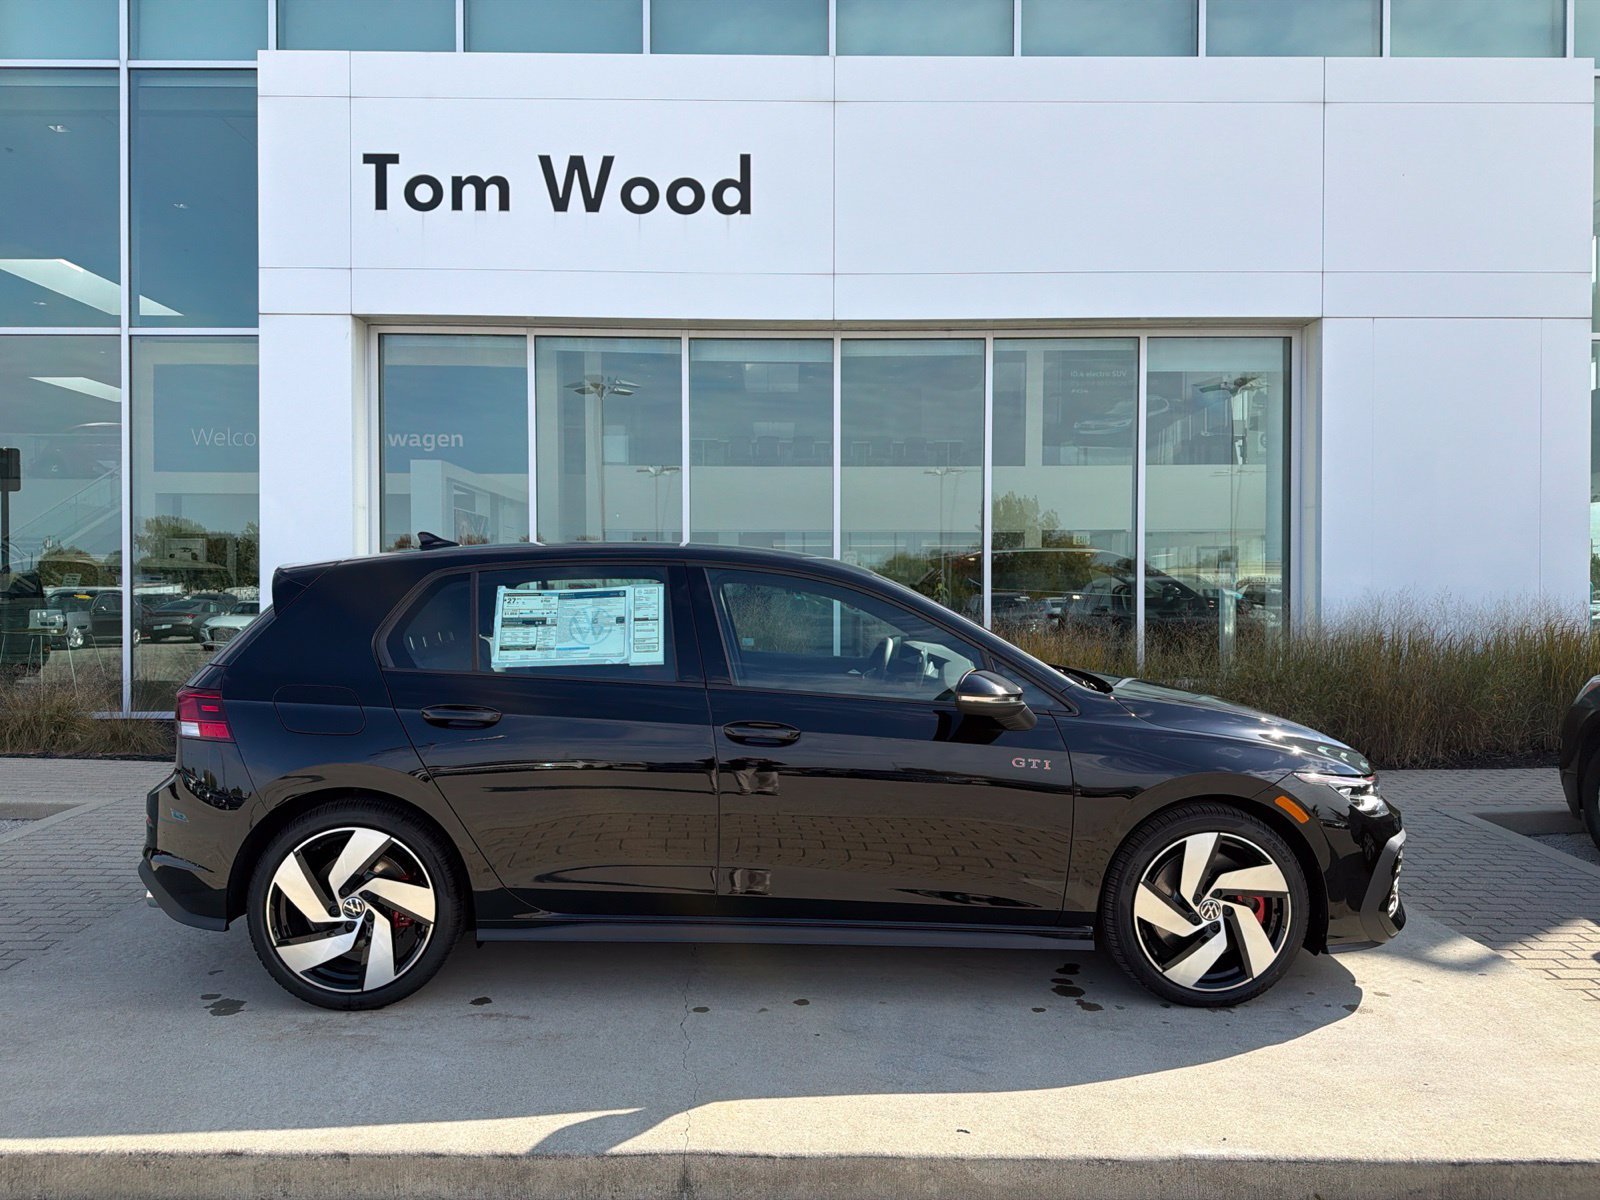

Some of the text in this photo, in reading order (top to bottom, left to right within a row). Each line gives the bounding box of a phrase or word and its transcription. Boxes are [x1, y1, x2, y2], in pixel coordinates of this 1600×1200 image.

[362, 153, 752, 215] Tom Wood
[1112, 369, 1128, 377] SUV
[385, 433, 464, 452] wagen
[1011, 757, 1052, 770] GTI
